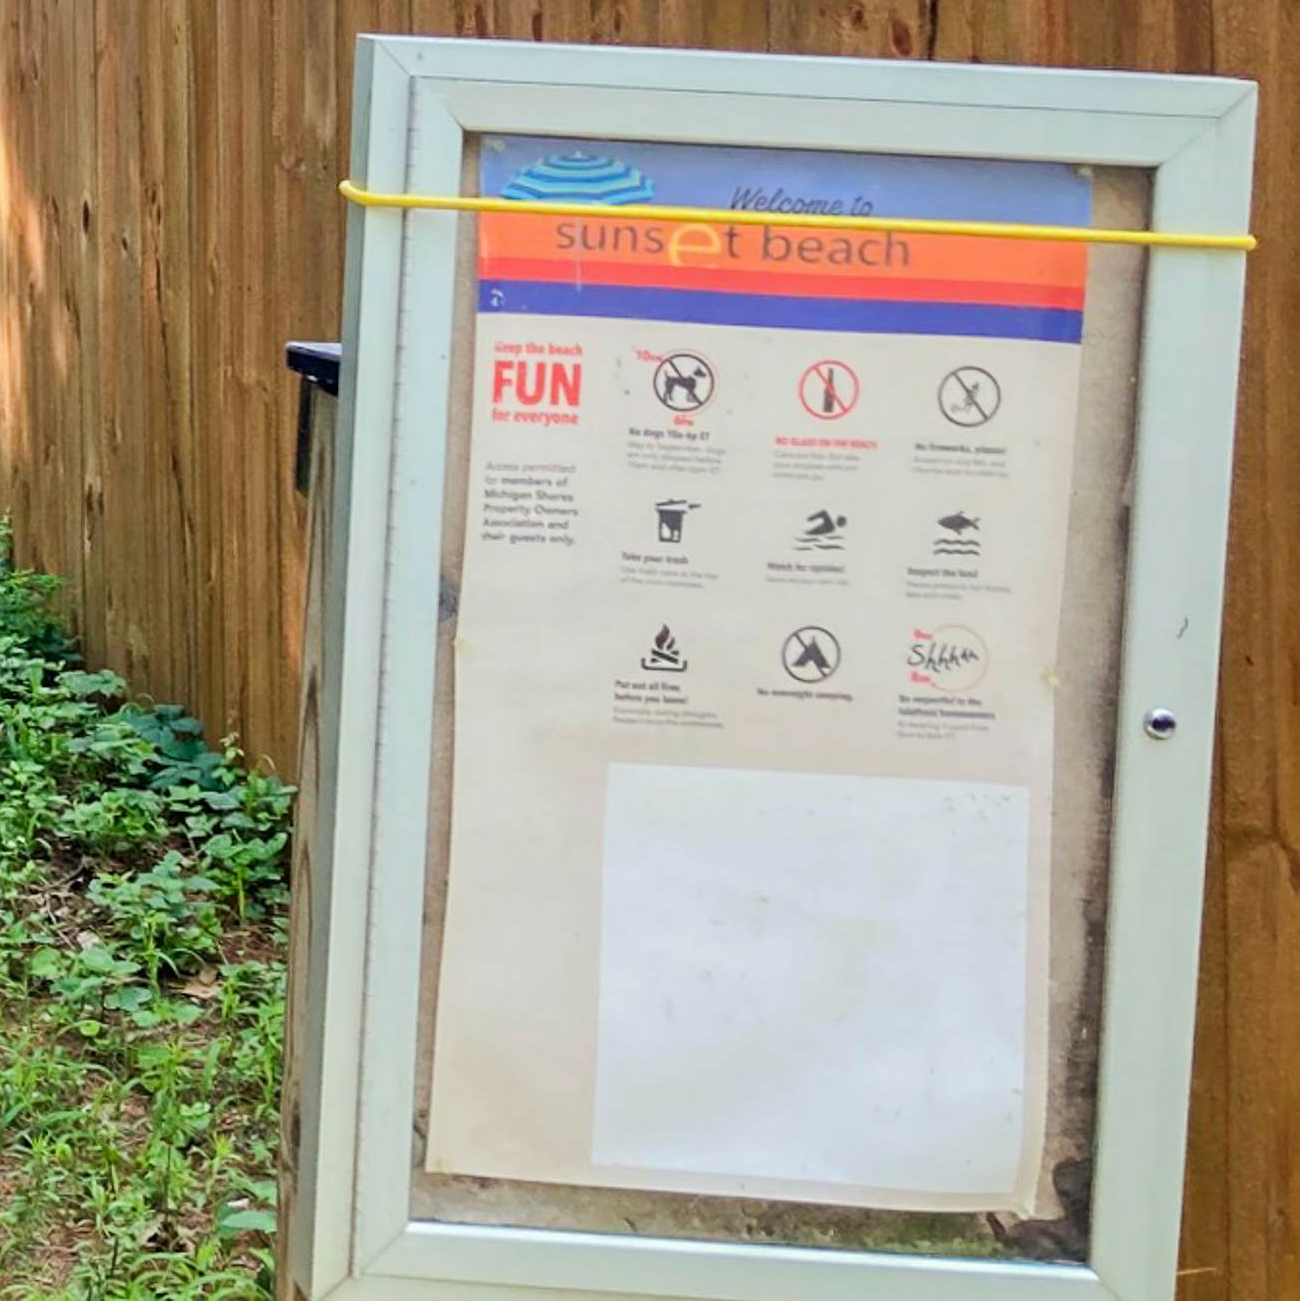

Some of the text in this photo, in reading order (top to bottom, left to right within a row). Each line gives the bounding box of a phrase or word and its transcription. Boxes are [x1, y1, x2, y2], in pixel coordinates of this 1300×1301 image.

[729, 186, 874, 217] Welcome to
[555, 220, 911, 269] sunset beach
[525, 342, 543, 354] the
[547, 342, 583, 357] beach
[492, 360, 582, 407] FUN
[492, 408, 579, 427] for everyone
